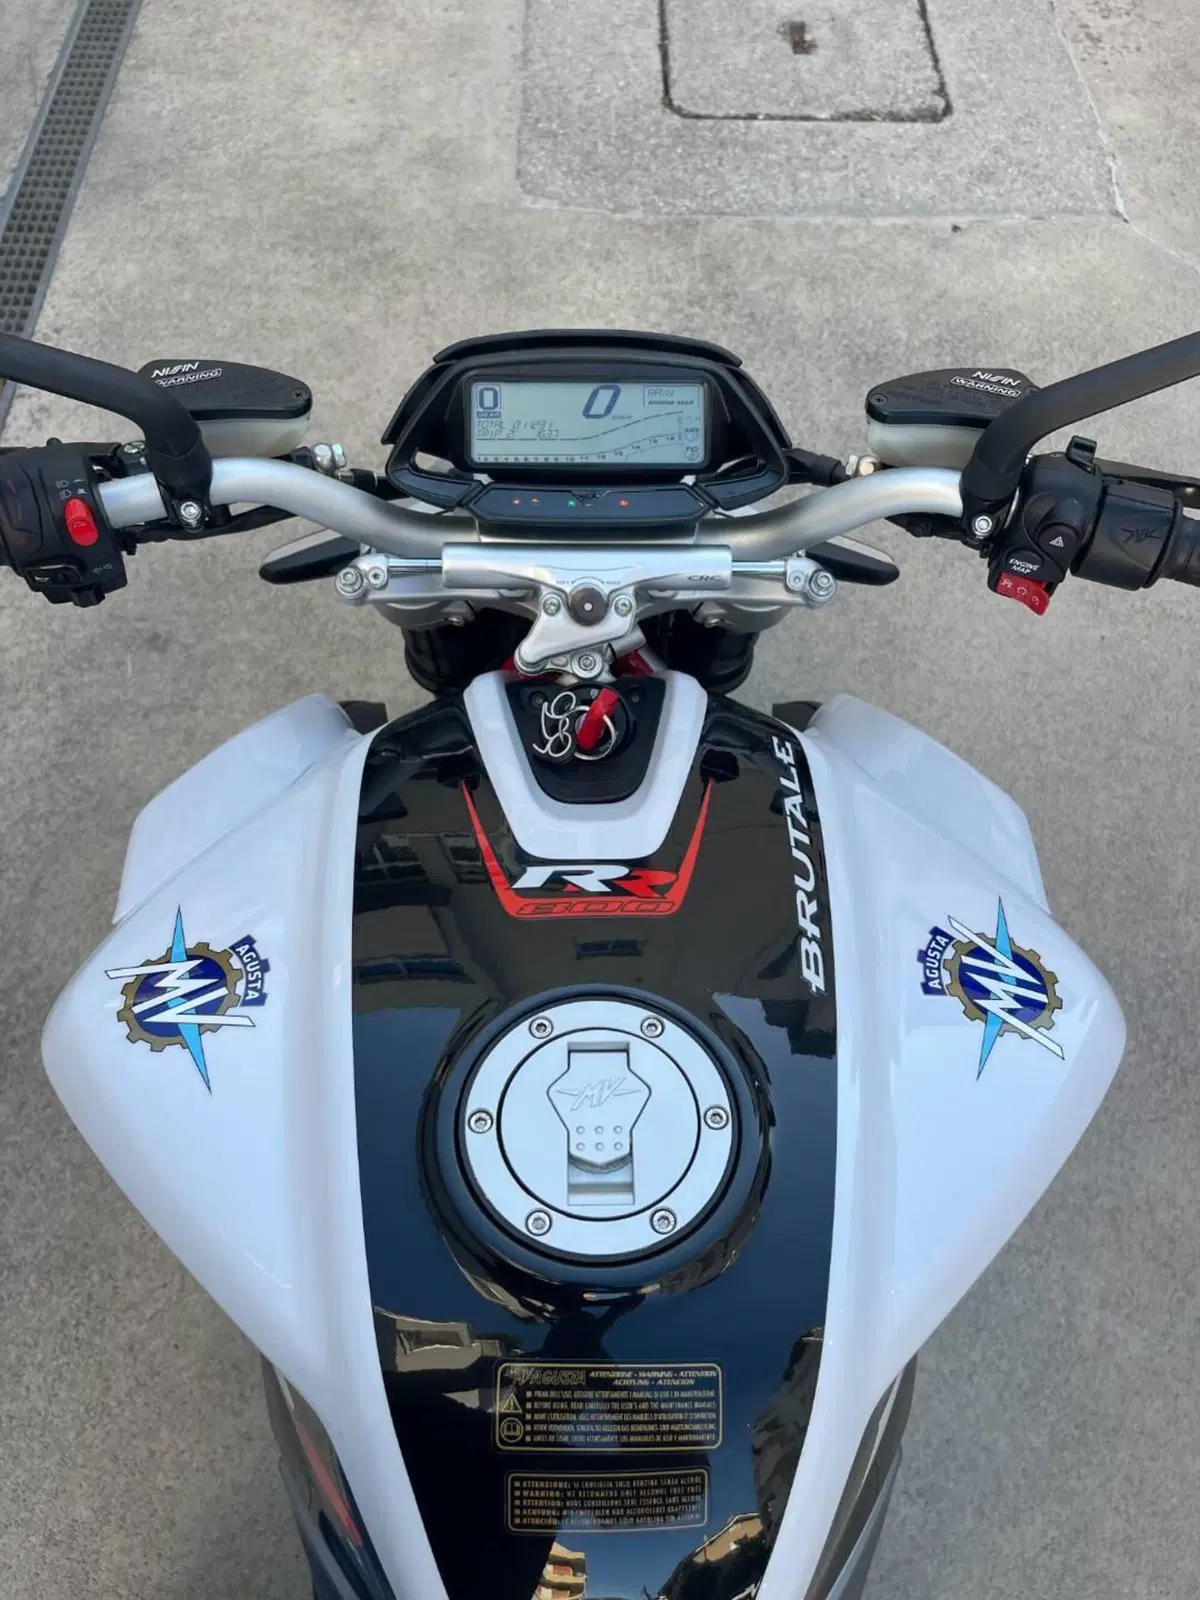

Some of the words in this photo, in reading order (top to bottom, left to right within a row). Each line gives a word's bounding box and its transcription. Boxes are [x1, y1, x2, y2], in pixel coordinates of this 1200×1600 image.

[955, 377, 1018, 397] WARNING
[479, 387, 498, 410] 0
[582, 384, 621, 419] 0
[1009, 558, 1040, 571] ENGINE
[1012, 565, 1031, 574] MAP
[687, 574, 722, 582] CRC
[772, 735, 826, 996] BRUTALE
[516, 901, 676, 916] 800
[235, 944, 260, 1000] AGUSTA
[925, 934, 949, 989] AGUSTA
